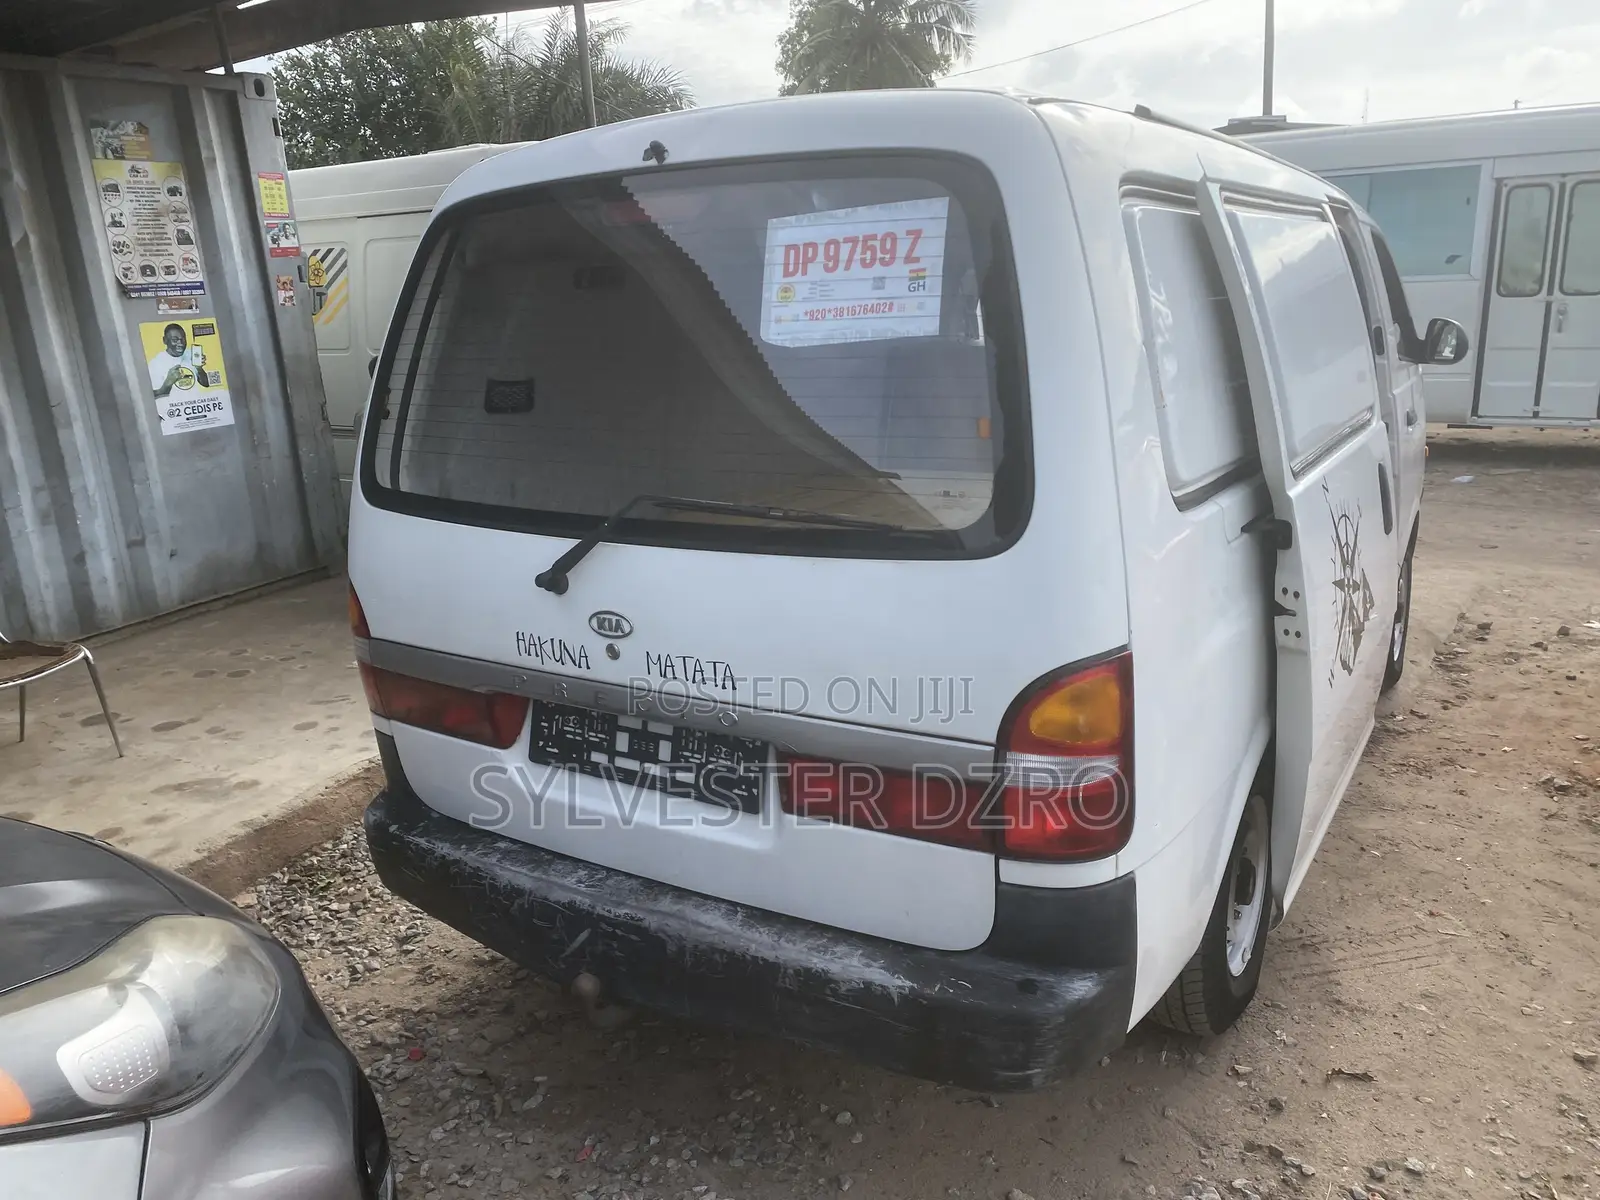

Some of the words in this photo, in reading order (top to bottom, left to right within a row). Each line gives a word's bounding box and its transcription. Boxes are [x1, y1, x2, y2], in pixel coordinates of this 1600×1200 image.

[783, 242, 818, 278] DP
[822, 231, 897, 273] 9759
[903, 228, 923, 265] Z
[908, 281, 926, 293] GH
[167, 408, 182, 418] @2
[183, 404, 212, 416] CEDIS
[596, 616, 626, 634] KIA
[516, 631, 591, 670] HAKUNA
[646, 651, 737, 690] MATATA
